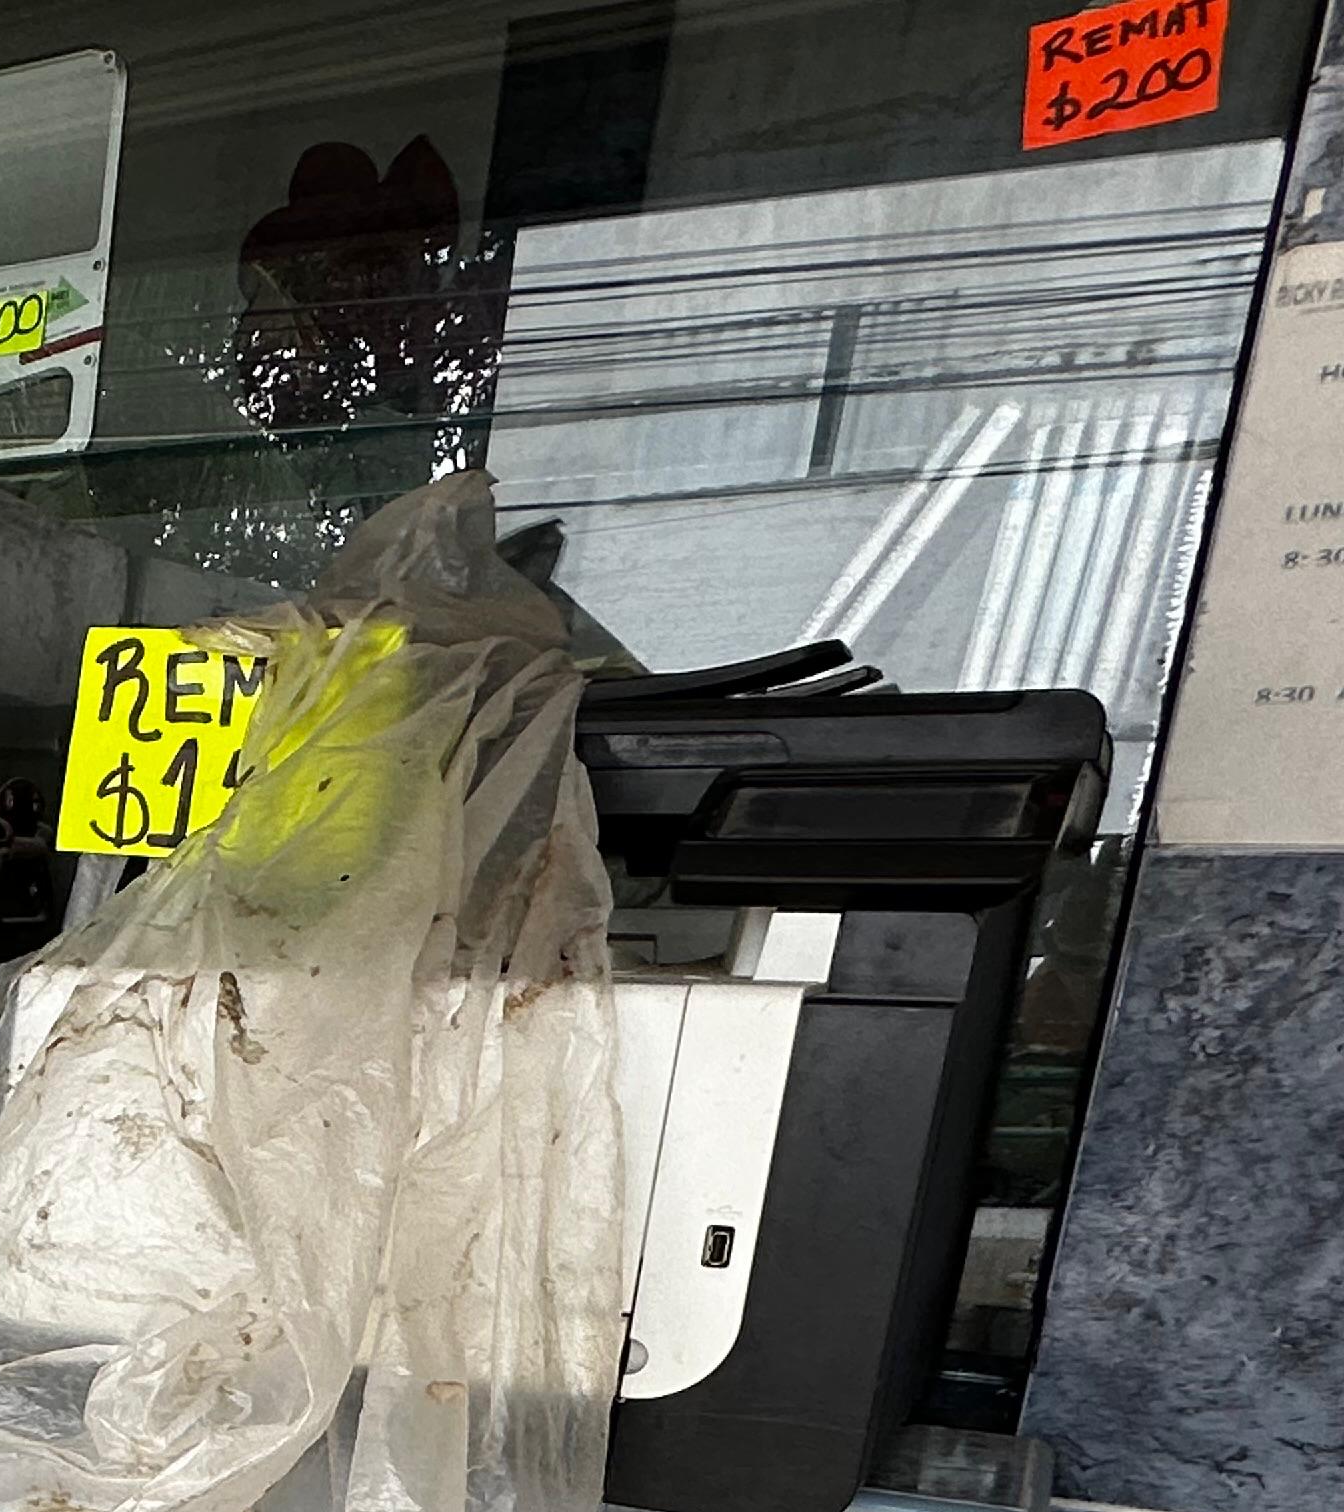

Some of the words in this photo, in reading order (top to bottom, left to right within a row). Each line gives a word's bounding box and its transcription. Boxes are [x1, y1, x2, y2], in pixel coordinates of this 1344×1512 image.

[1041, 0, 1212, 72] REMAT
[1041, 47, 1212, 131] $200
[95, 637, 269, 743] REM
